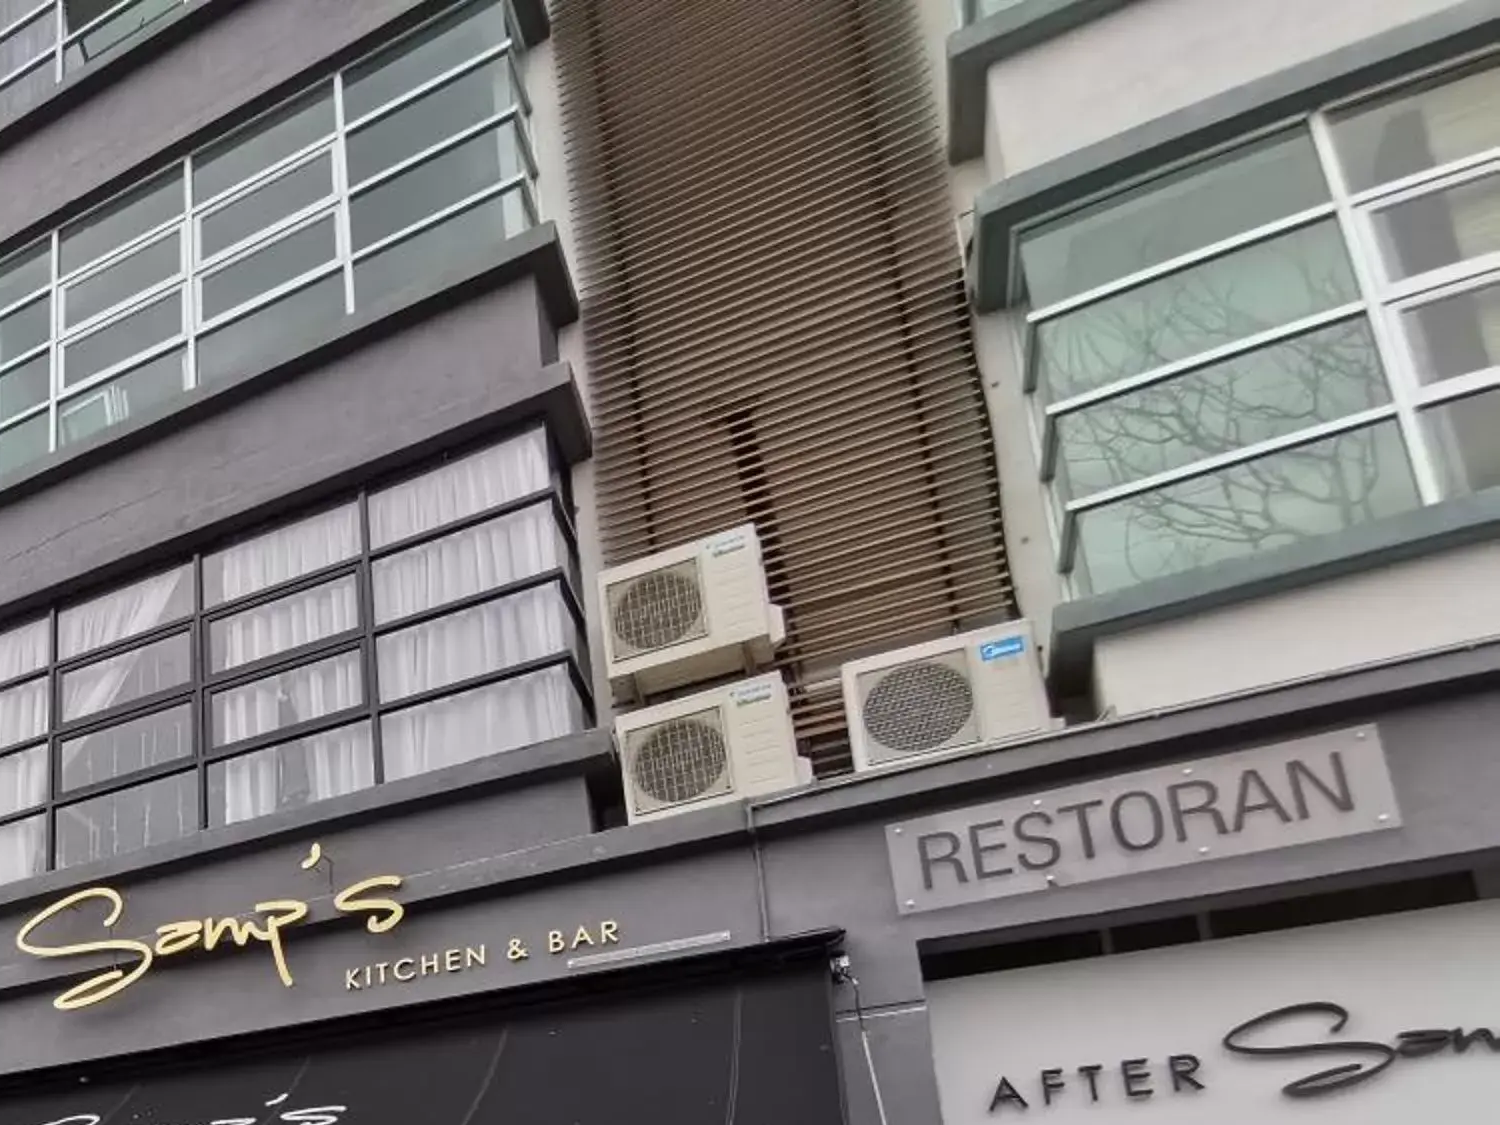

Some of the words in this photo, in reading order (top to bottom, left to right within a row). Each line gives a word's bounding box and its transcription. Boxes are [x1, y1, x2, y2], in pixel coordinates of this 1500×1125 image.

[916, 751, 1356, 890] RESTORAN
[15, 842, 404, 1010] Samp's
[344, 944, 486, 990] KITCHEN
[506, 938, 529, 960] &
[549, 920, 620, 953] BAR
[988, 1052, 1206, 1113] AFTER
